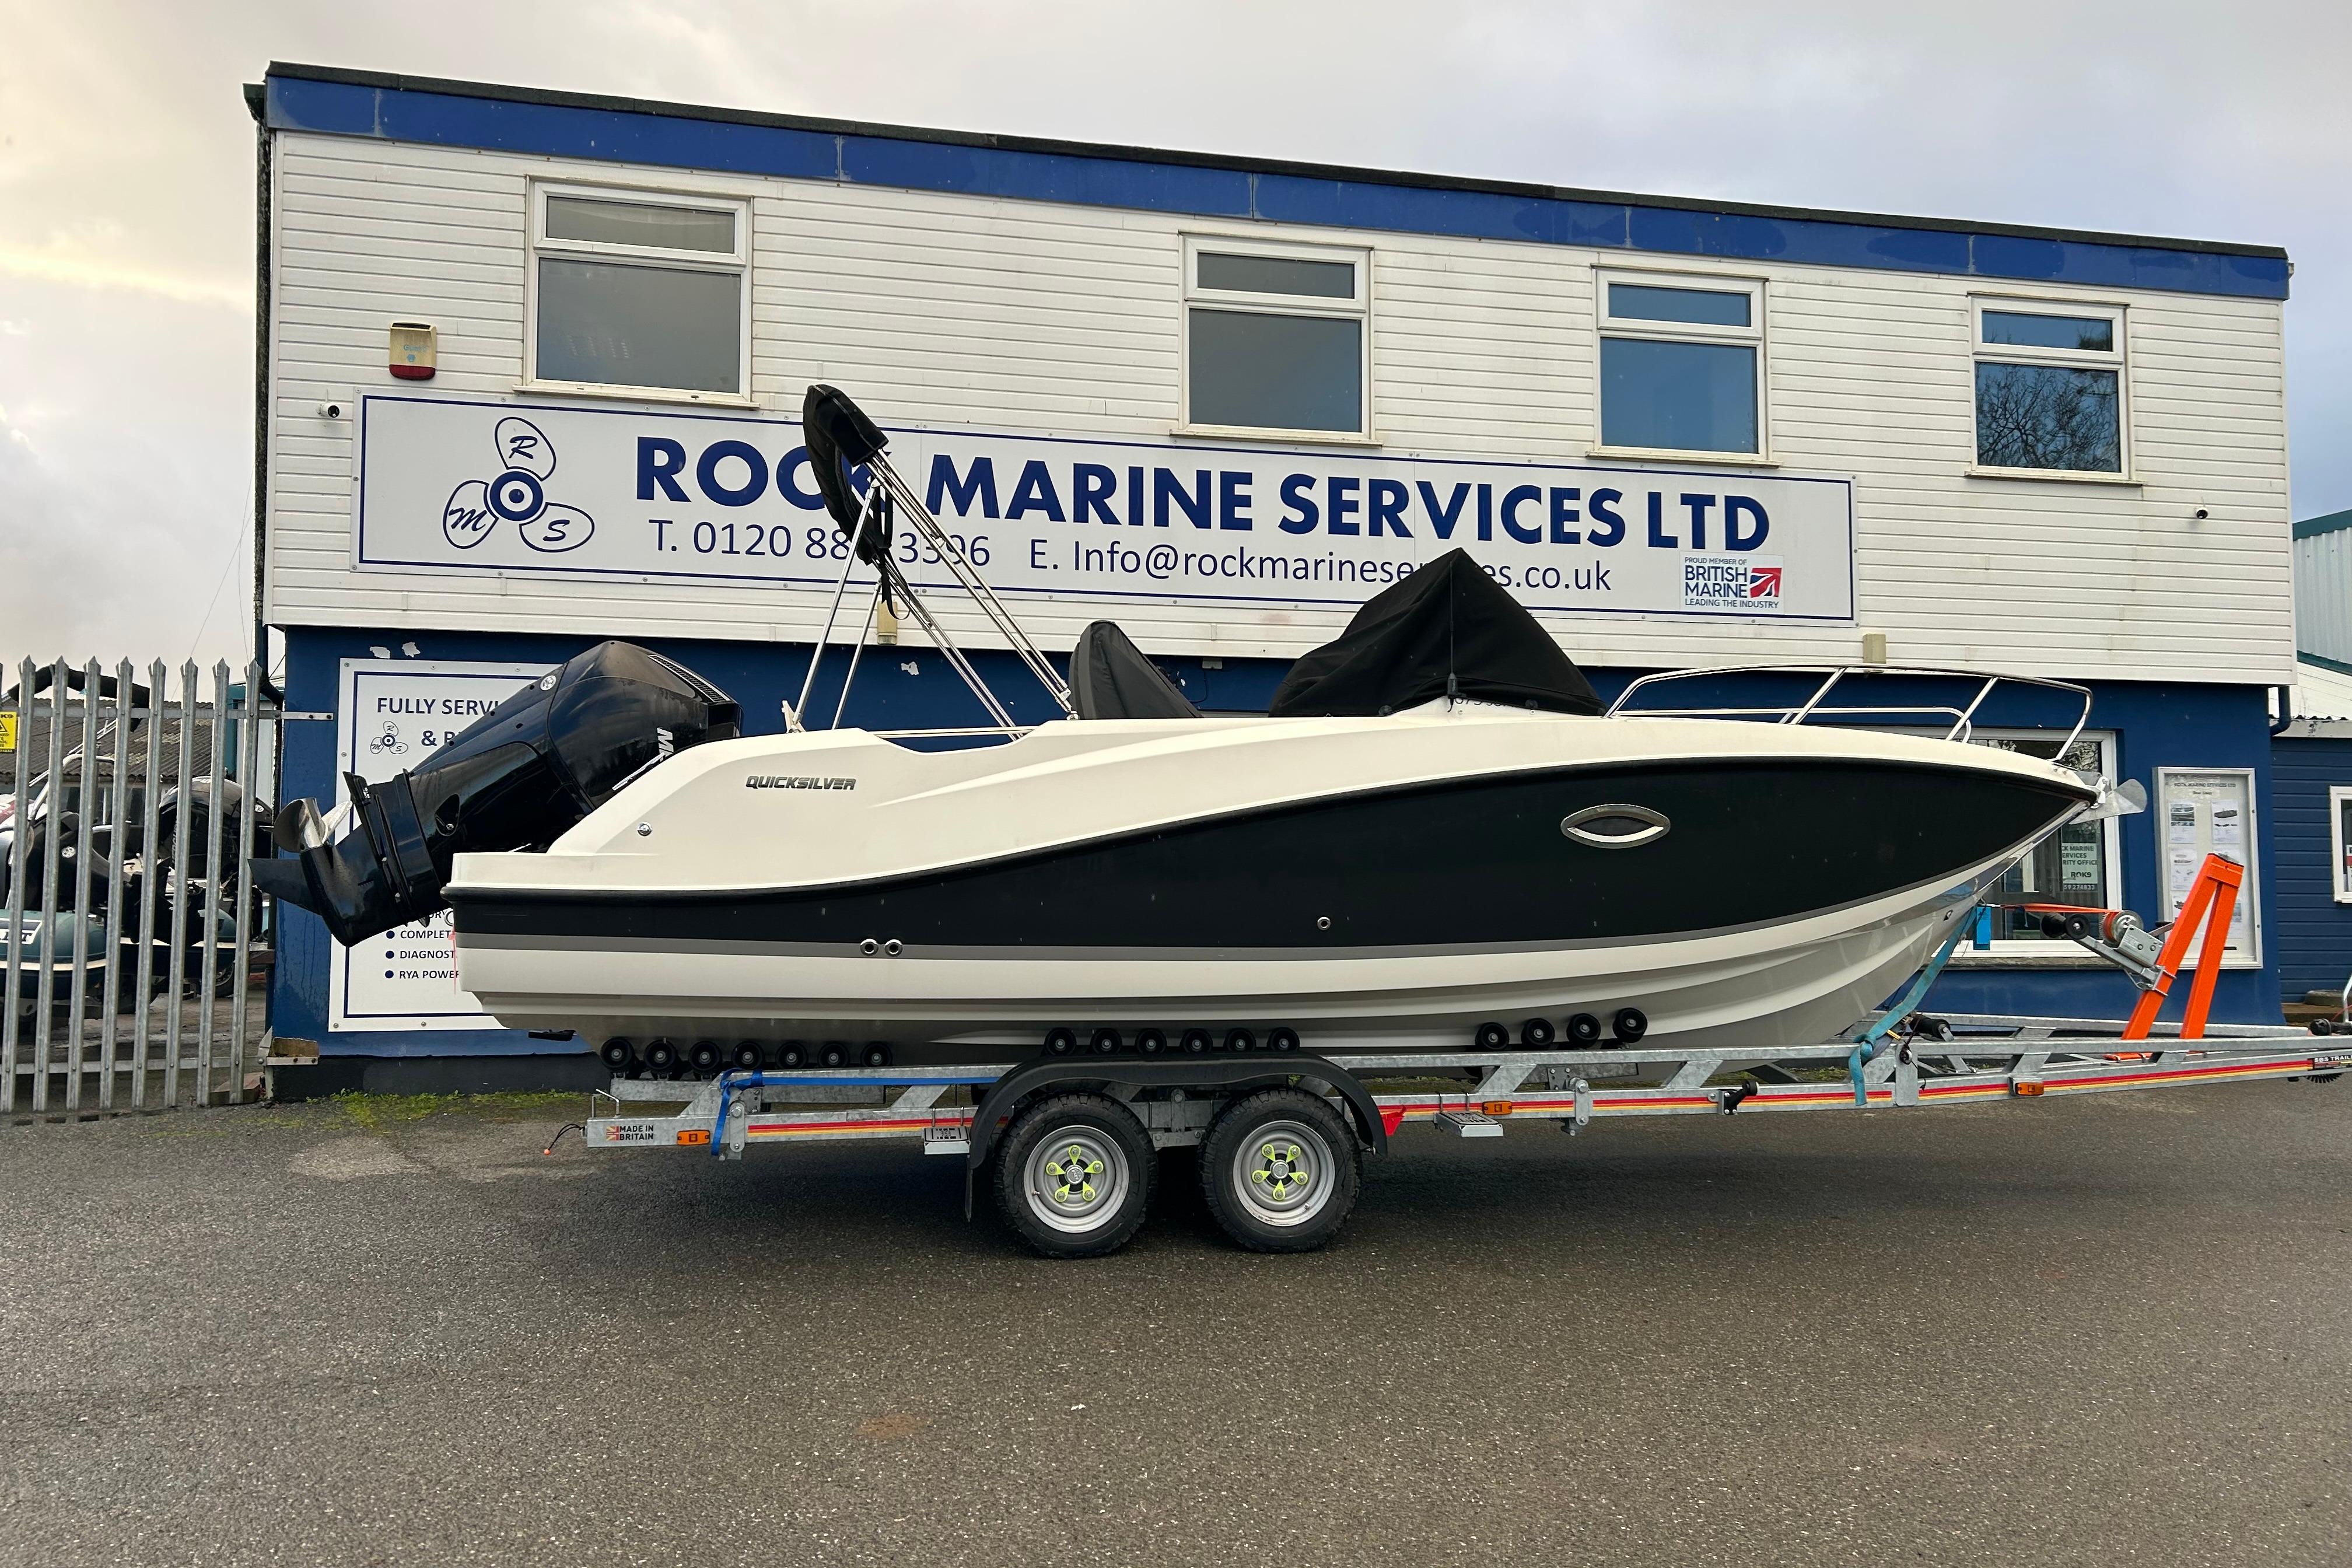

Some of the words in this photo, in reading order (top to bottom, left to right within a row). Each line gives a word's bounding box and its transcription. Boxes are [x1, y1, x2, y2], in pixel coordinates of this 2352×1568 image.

[508, 435, 538, 460] R
[925, 453, 1254, 531] MARINE
[1278, 473, 1626, 548] SERVICES
[1647, 491, 1770, 551] LTD
[542, 519, 571, 542] S
[648, 519, 678, 551] T.
[693, 522, 792, 558] 0120
[805, 527, 852, 561] 88
[1030, 539, 1059, 570] E.
[1685, 565, 1747, 583] BRITISH
[1685, 583, 1748, 598] MARINE
[1685, 598, 1720, 607] LEADING
[1723, 599, 1737, 607] THE
[1740, 600, 1779, 609] INDUSTRY
[377, 697, 436, 714] FULLY
[421, 730, 438, 747] &
[746, 776, 856, 790] QUICKSILVER
[400, 930, 451, 939] COMPLET
[400, 950, 454, 959] DIAGNOST
[399, 971, 419, 979] RYA
[619, 1133, 654, 1141] BRITAIN
